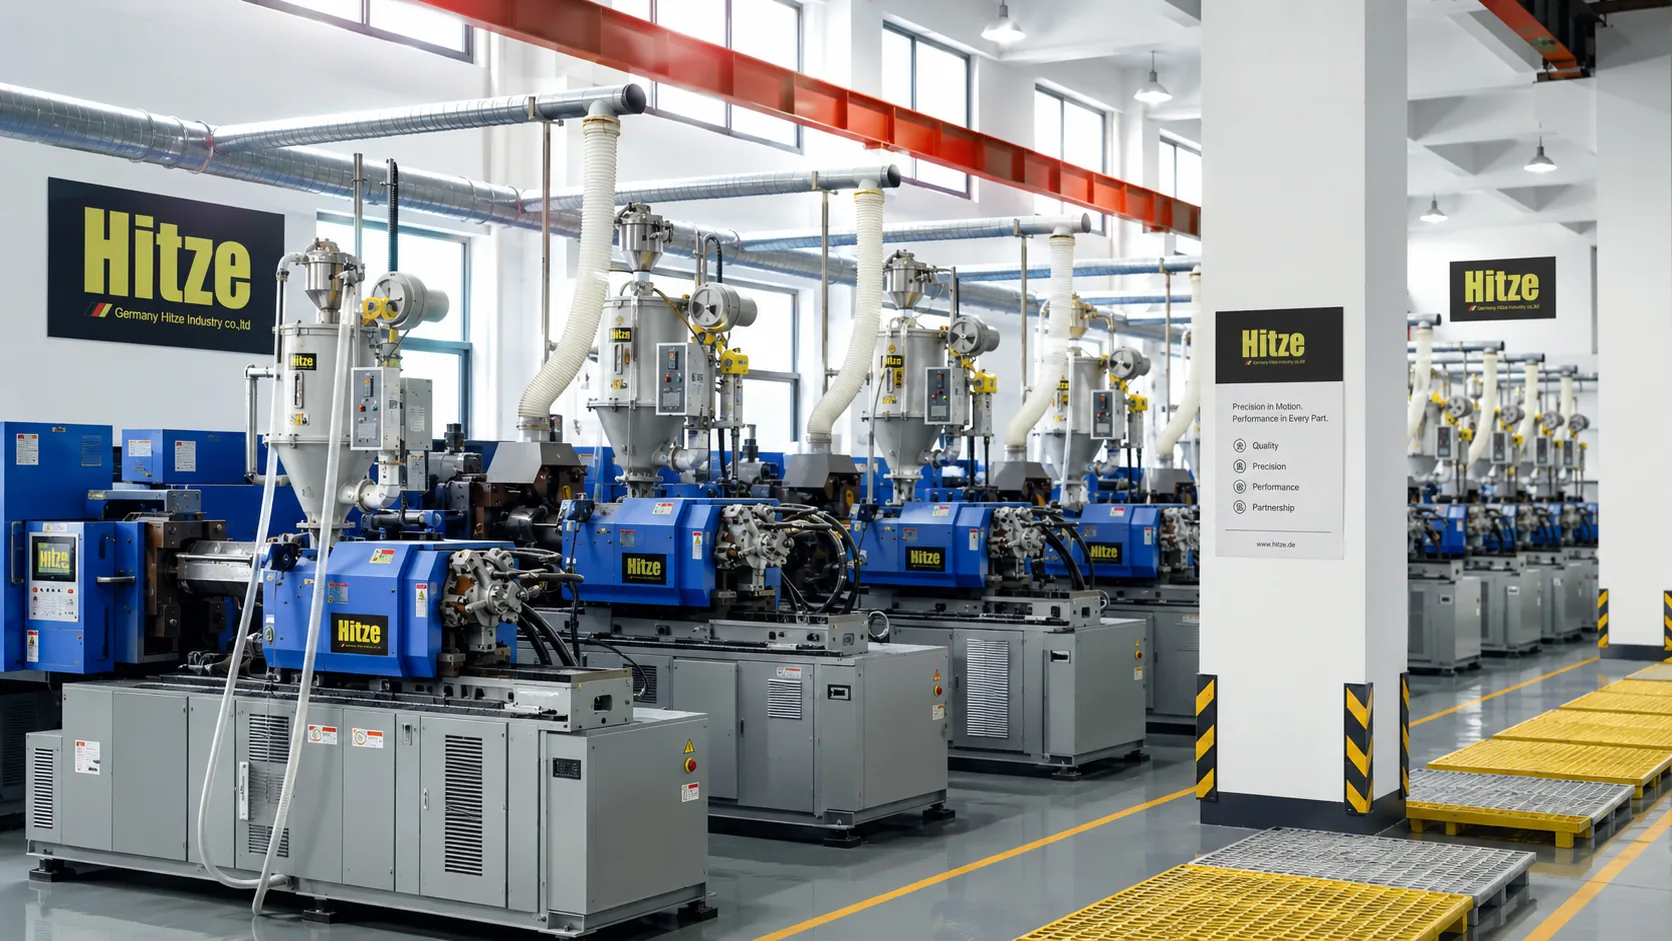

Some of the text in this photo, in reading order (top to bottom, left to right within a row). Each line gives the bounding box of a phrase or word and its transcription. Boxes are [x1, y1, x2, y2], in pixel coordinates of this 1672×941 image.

[84, 206, 251, 309] Hitze
[1465, 270, 1539, 303] Hitze
[115, 307, 158, 324] Germany
[161, 311, 185, 324] Hitze
[187, 314, 223, 330] Industry
[1242, 329, 1305, 358] Hitze
[1232, 402, 1303, 411] Precision in Motion.
[1280, 414, 1287, 422] in
[1288, 414, 1309, 423] Every
[1311, 414, 1329, 422] Part.
[1252, 441, 1279, 451] Quality
[1252, 462, 1287, 470] Precision
[1252, 482, 1300, 491] Performance
[1252, 503, 1295, 513] Partnership
[911, 550, 941, 565] Hitze
[1091, 545, 1118, 558] Hitze
[627, 557, 661, 576] Hitze
[338, 619, 381, 644] Hitze
